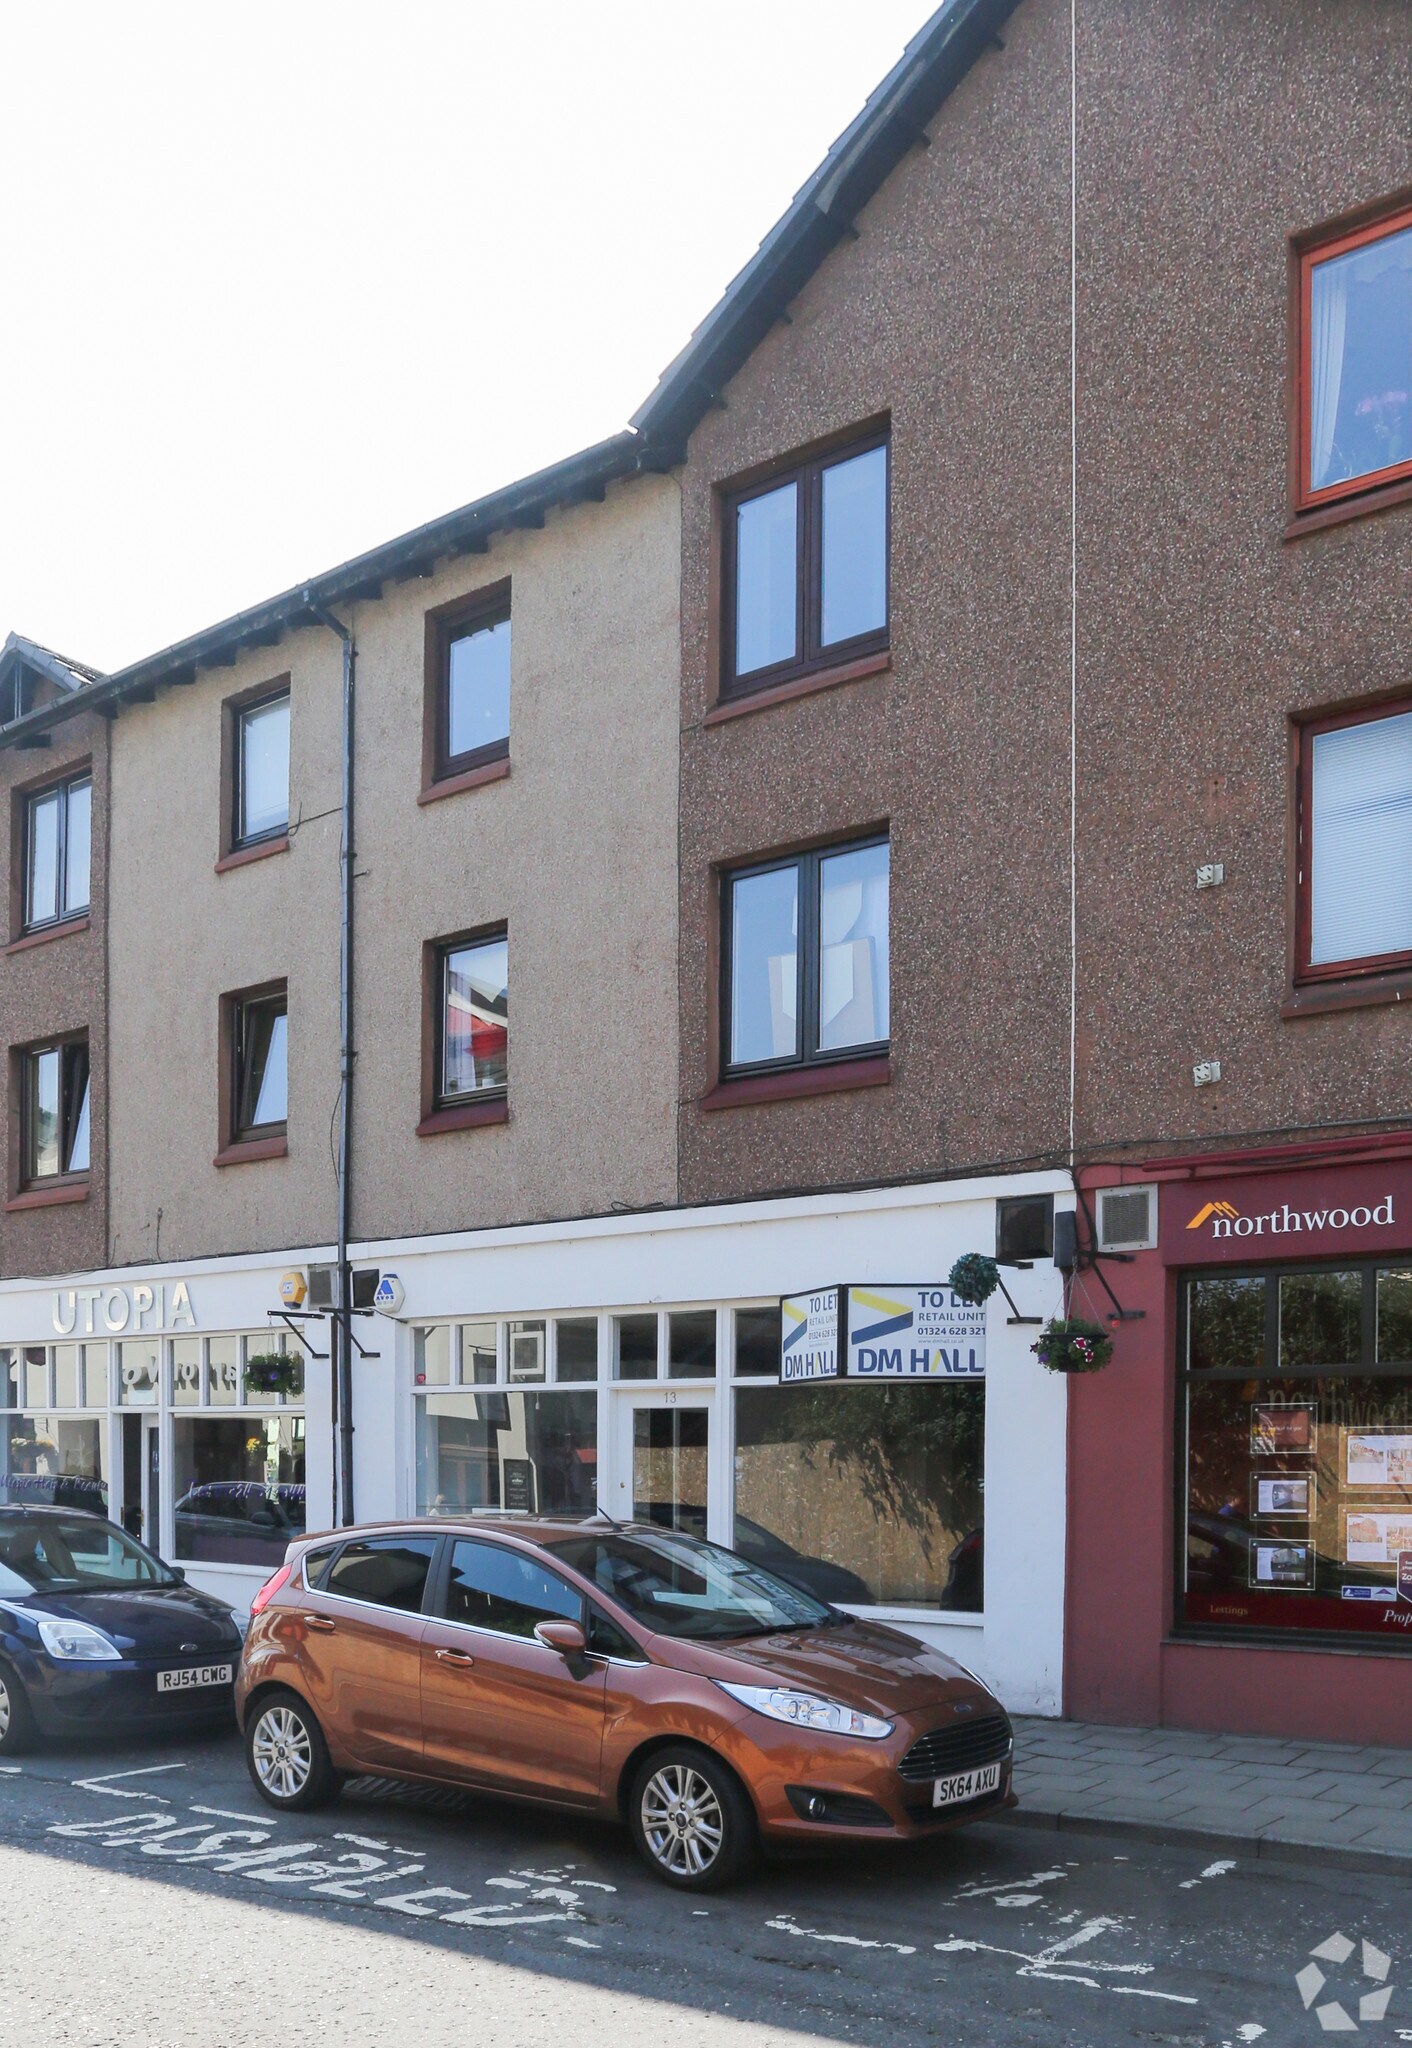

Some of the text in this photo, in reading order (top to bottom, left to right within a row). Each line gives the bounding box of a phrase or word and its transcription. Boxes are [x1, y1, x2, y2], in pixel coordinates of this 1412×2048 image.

[1212, 1195, 1395, 1238] northwood
[52, 1282, 196, 1334] UTOPIA
[809, 1294, 838, 1314] TO LET
[918, 1291, 944, 1308] TO
[809, 1313, 838, 1327] RETAIL UNIT
[919, 1312, 986, 1321] RETAIL UNIT
[809, 1331, 821, 1340] 01324
[822, 1329, 830, 1338] 628
[918, 1327, 986, 1336] 01324 628 321
[785, 1349, 838, 1379] DM HALL
[858, 1348, 985, 1373] DM HALL
[664, 1391, 677, 1404] 13
[1210, 1604, 1249, 1617] Lettings
[163, 1666, 227, 1688] RJ54 CWG
[940, 1766, 997, 1802] SK64 AXU
[46, 1812, 588, 1927] DISABLED
